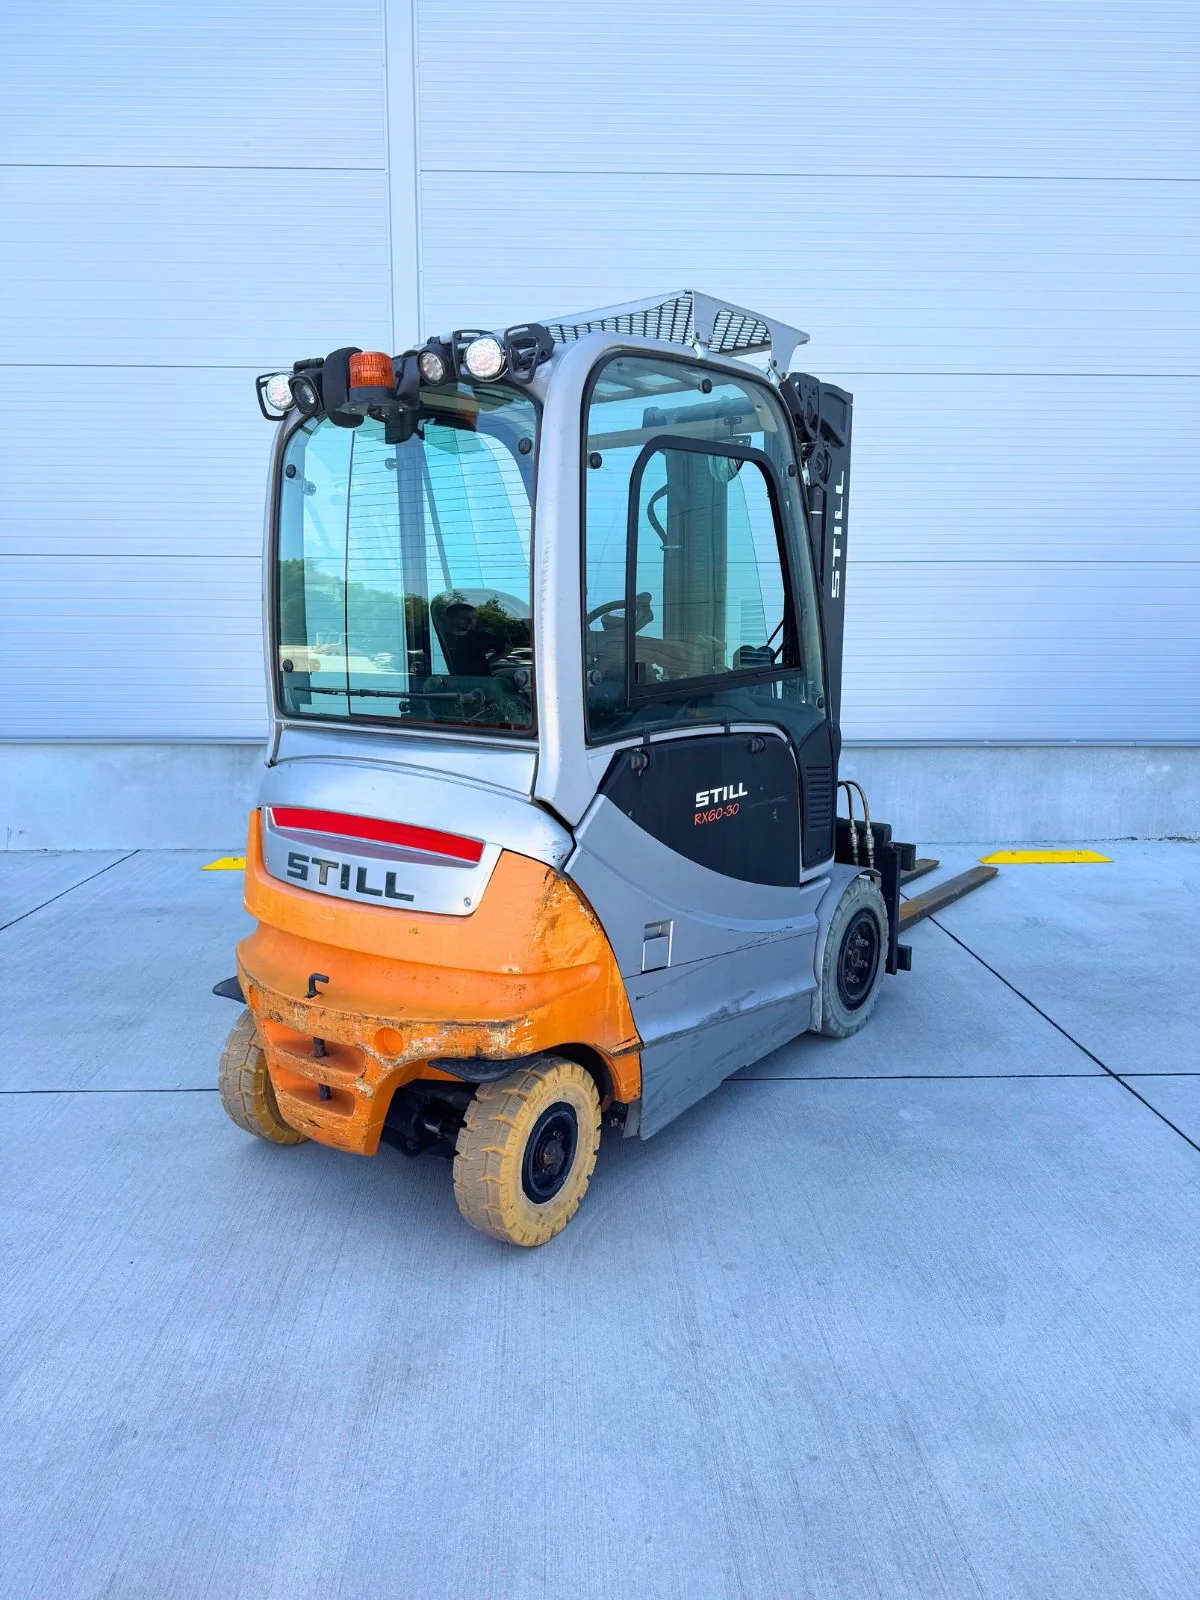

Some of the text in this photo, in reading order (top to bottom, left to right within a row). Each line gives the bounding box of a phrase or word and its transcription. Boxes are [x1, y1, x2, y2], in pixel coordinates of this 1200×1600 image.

[832, 471, 845, 599] STILL
[695, 782, 748, 808] STILL
[693, 803, 740, 826] RX60-30
[286, 852, 415, 903] STILL
